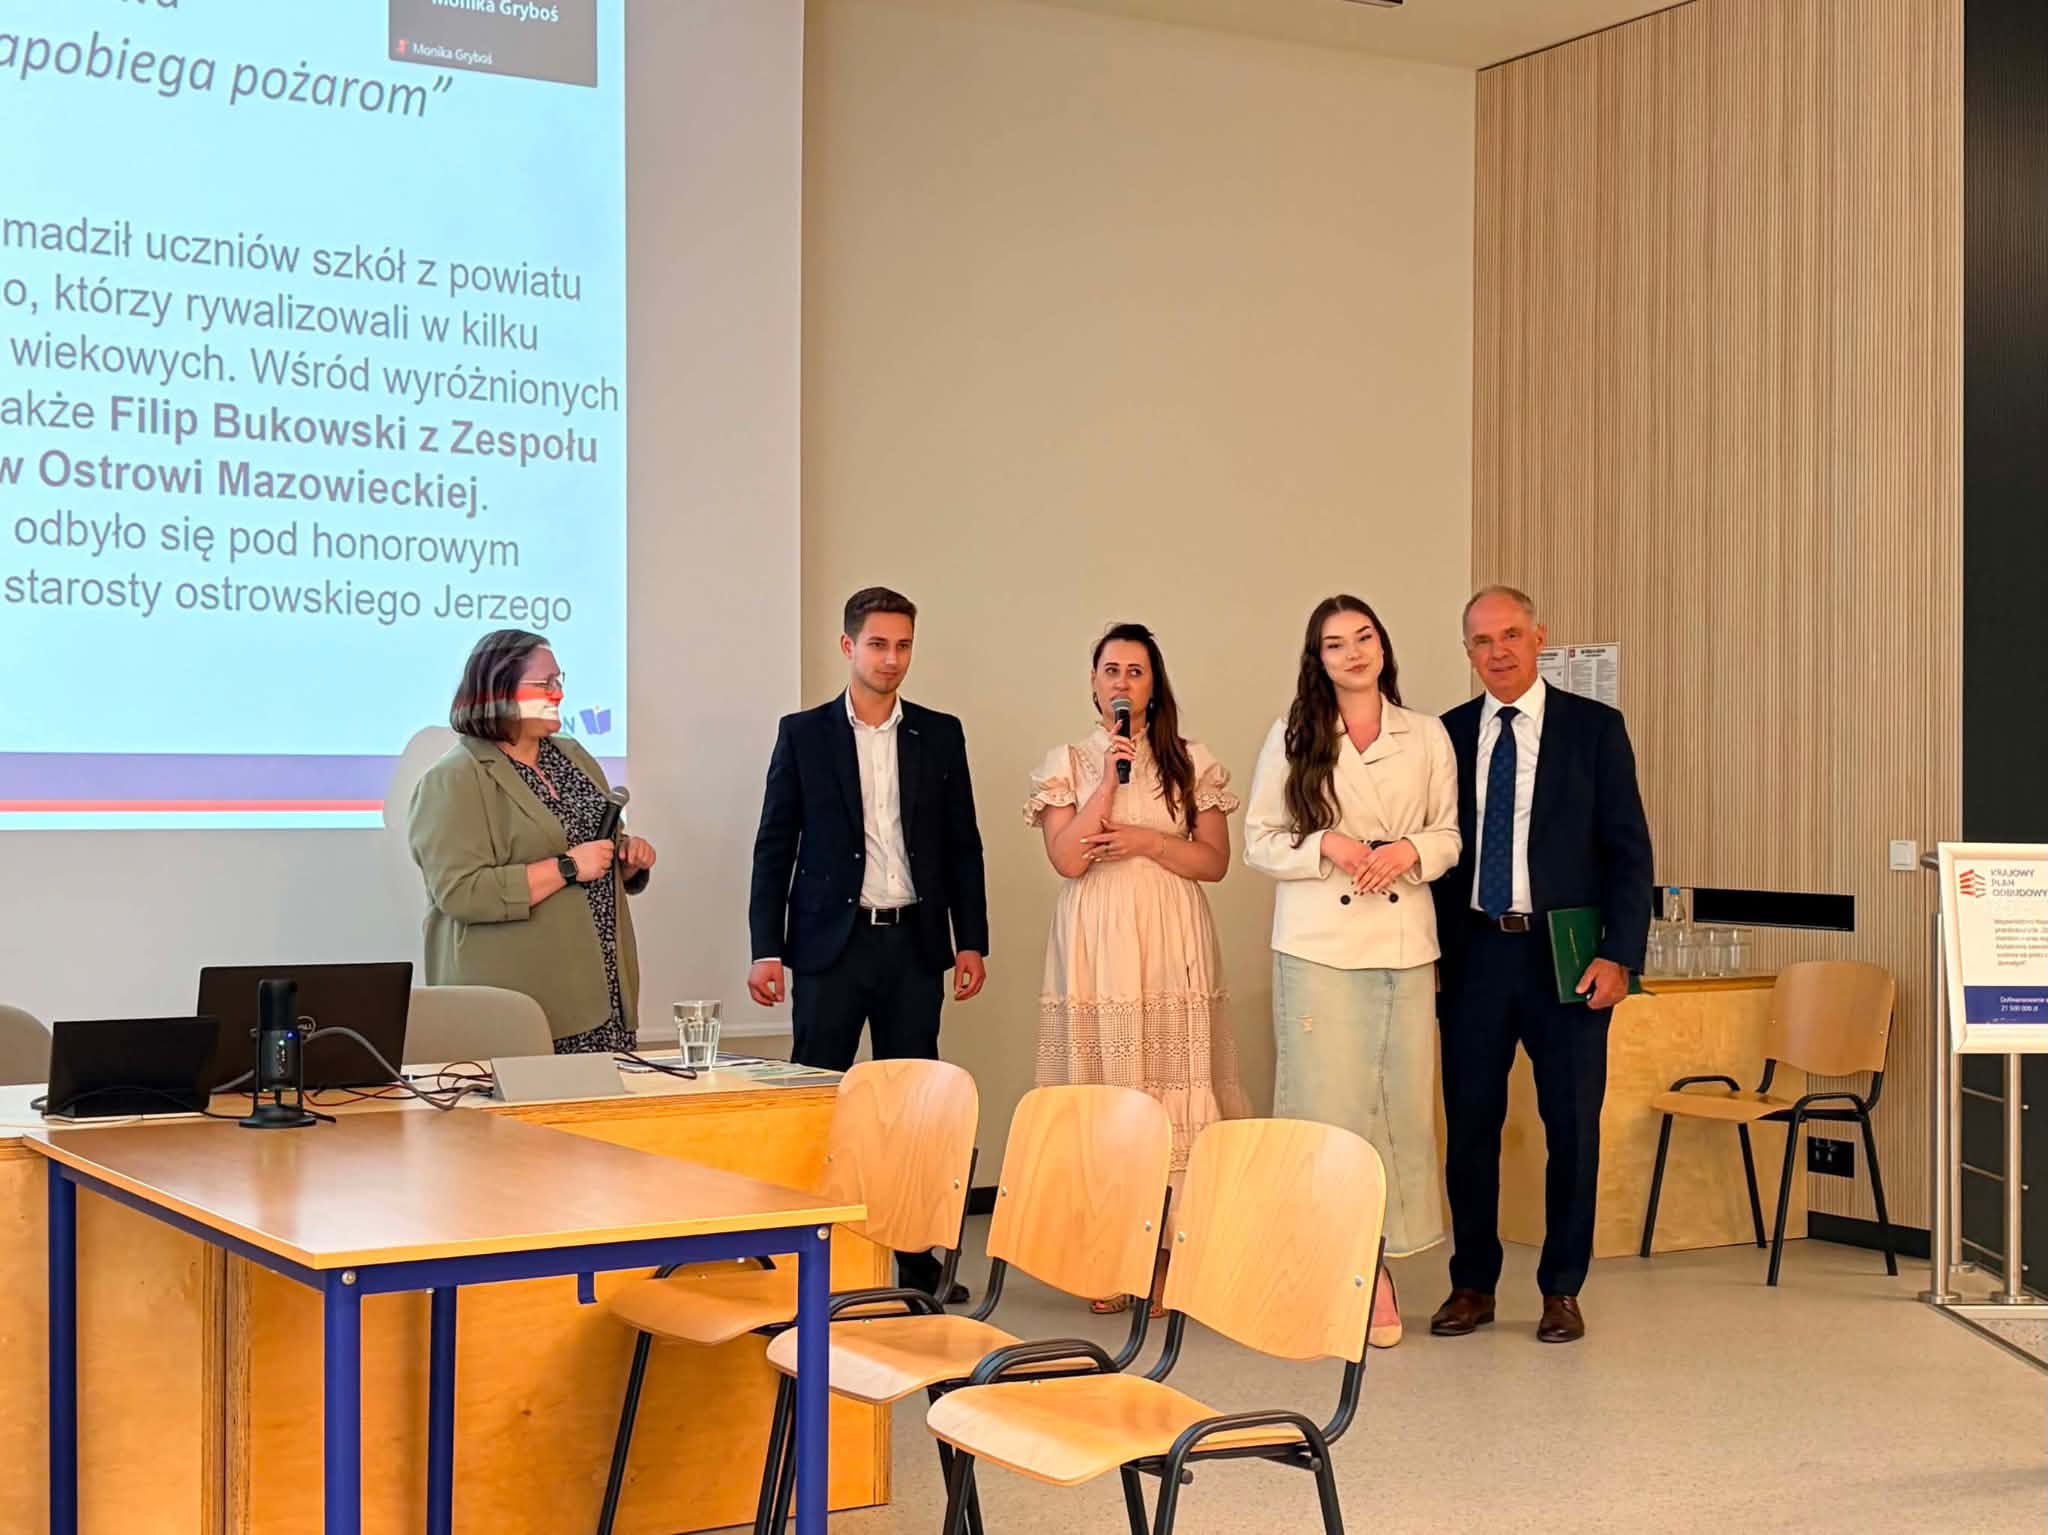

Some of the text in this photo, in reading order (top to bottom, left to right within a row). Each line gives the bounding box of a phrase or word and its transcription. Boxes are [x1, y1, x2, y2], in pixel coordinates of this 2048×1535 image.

[500, 0, 559, 22] Gryboś
[0, 31, 216, 98] apobiega
[413, 43, 493, 65] Monika Gryboś
[2, 217, 581, 302] madził uczniów szkół z powiatu
[55, 273, 173, 329] którzy
[186, 293, 409, 341] rywalizowali
[420, 314, 451, 343] w
[462, 310, 538, 352] kilku
[9, 331, 618, 417] wiekowych. Wśród wyróżnionych
[0, 389, 597, 468] akże Filip Bukowski z Zespołu
[38, 449, 203, 495] Ostrowi
[218, 459, 488, 520] Mazowieckiej.
[13, 509, 519, 574] odbyło się pod honorowym
[3, 567, 572, 631] starosty ostrowskiego Jerzego
